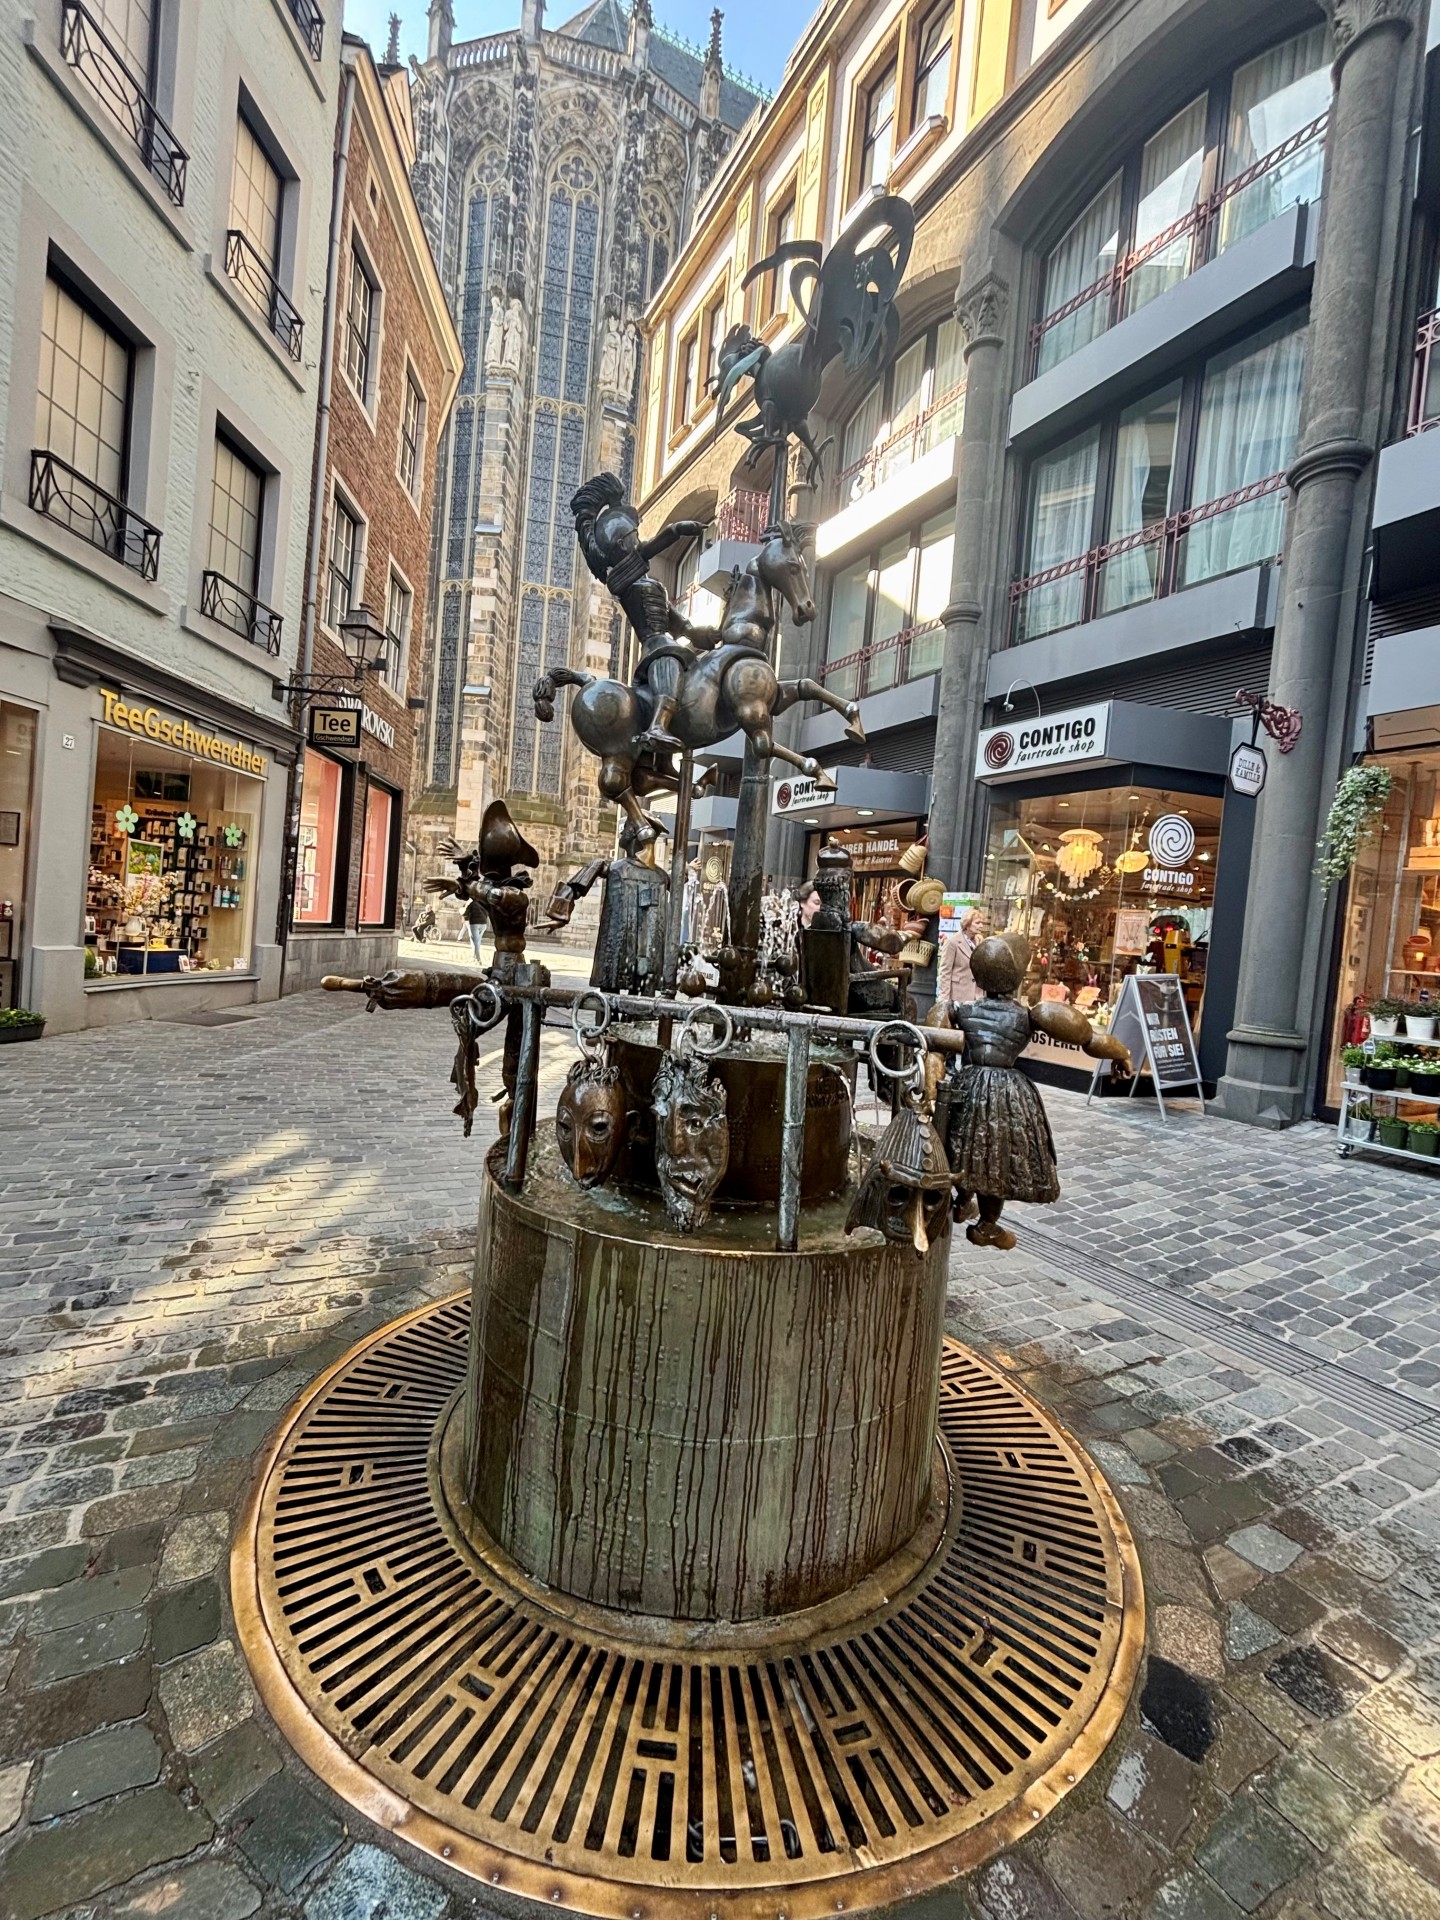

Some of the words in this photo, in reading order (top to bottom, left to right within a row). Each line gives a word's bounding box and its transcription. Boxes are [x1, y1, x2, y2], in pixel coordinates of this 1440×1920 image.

[319, 713, 351, 732] Tee
[100, 687, 268, 775] TeeGschwendner
[315, 733, 354, 743] Gschwendner
[1019, 717, 1096, 750] CONTIGO
[64, 736, 74, 747] 27
[1014, 743, 1065, 765] fairtrade
[1068, 739, 1095, 753] shop
[794, 780, 816, 796] CONT
[866, 839, 899, 853] HANDEL
[1143, 868, 1194, 885] CONTIGO
[1176, 885, 1194, 895] shop
[1149, 1026, 1179, 1042] RÖSTEN
[1153, 1042, 1168, 1059] FÜR
[1168, 1043, 1185, 1058] SIE!
